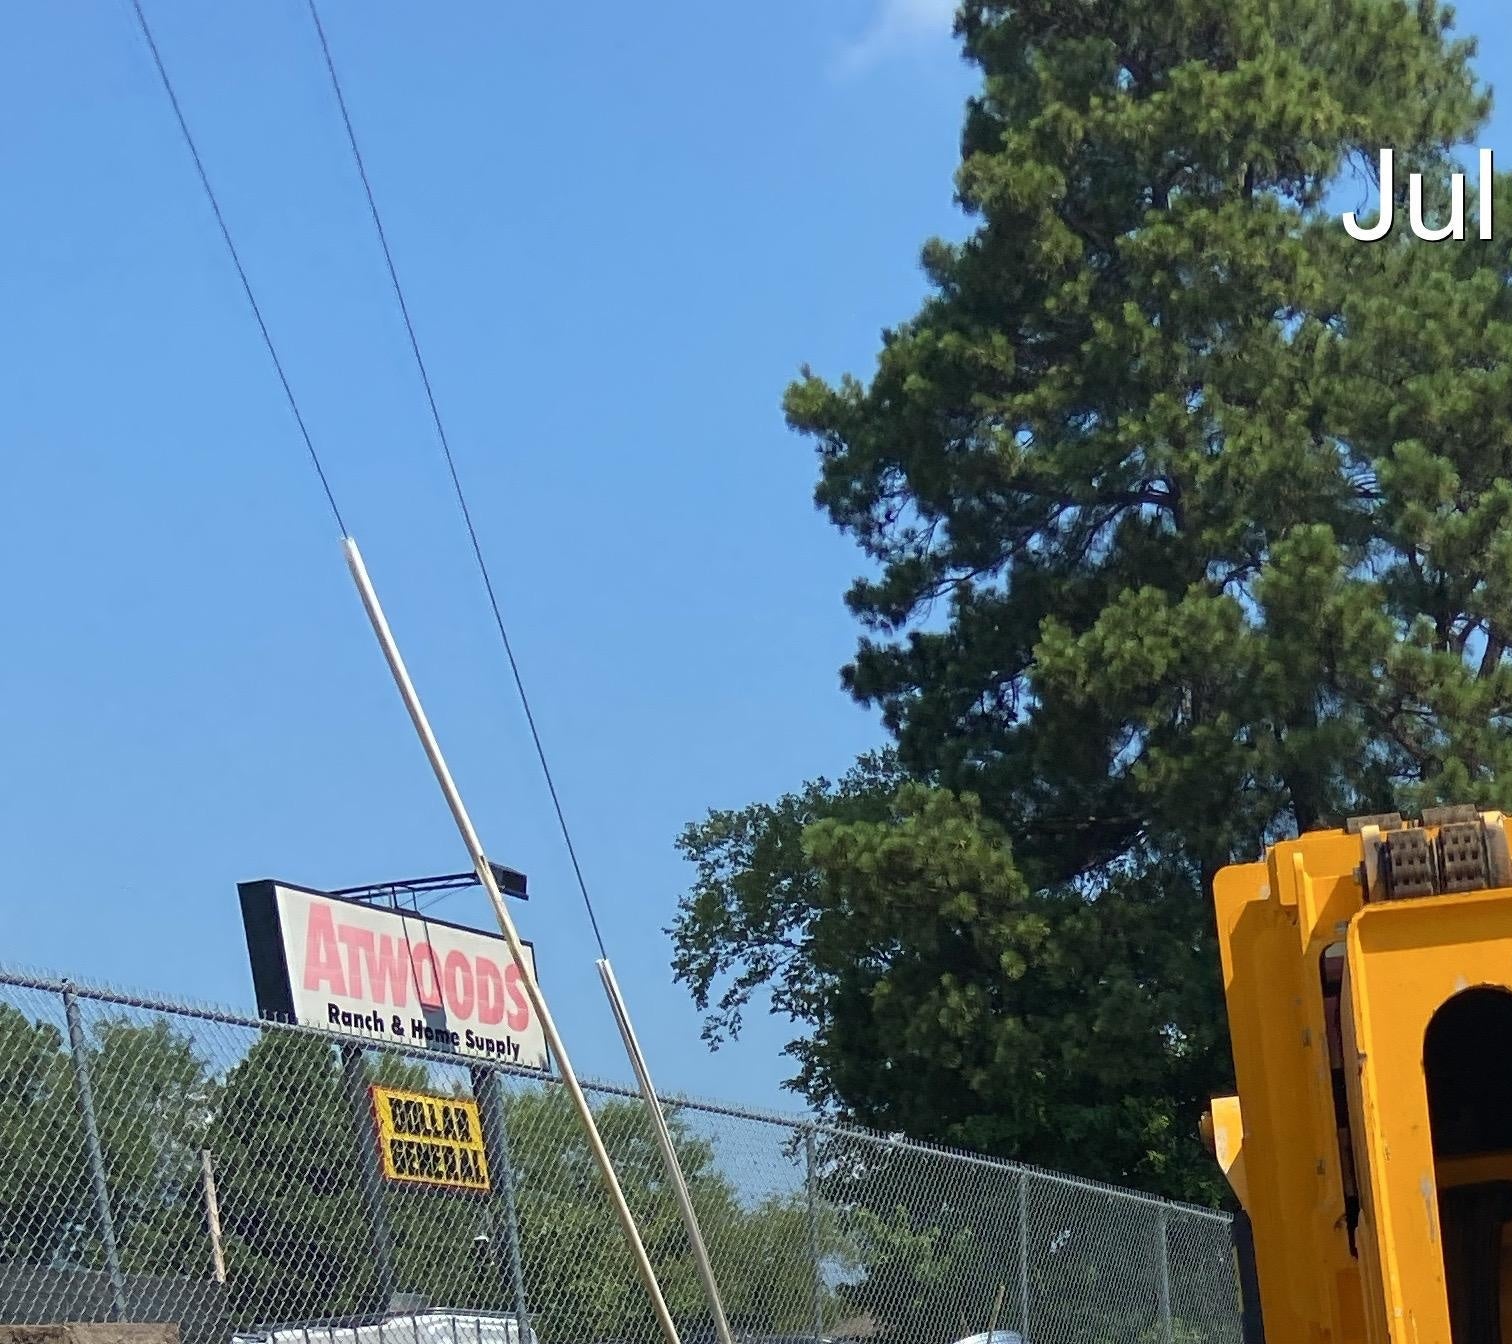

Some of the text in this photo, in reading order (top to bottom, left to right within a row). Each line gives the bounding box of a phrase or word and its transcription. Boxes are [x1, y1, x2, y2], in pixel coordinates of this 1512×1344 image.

[303, 902, 529, 1032] ATWOODS
[327, 1002, 521, 1061] Ranch & Home Supply
[388, 1097, 473, 1143] DOLLAR
